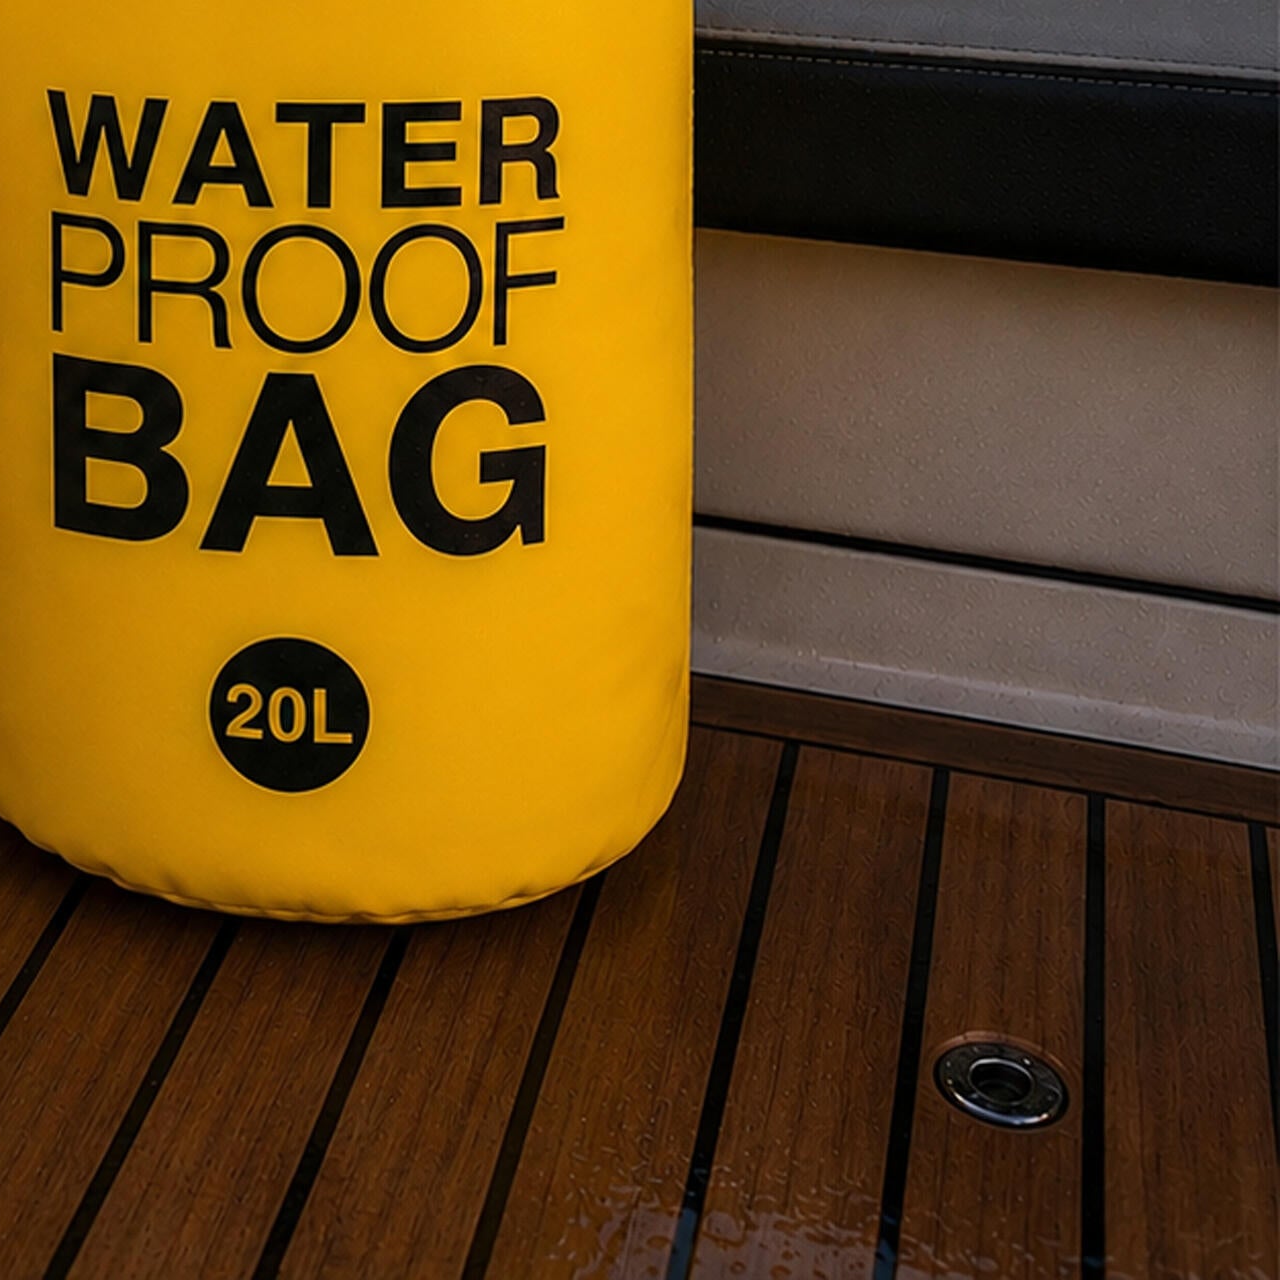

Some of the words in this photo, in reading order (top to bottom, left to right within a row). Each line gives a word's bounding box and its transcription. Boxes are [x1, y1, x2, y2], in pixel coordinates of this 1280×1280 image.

[47, 89, 560, 209] WATER
[51, 211, 565, 354] PROOF
[52, 353, 547, 557] BAG
[225, 683, 353, 744] 20L
